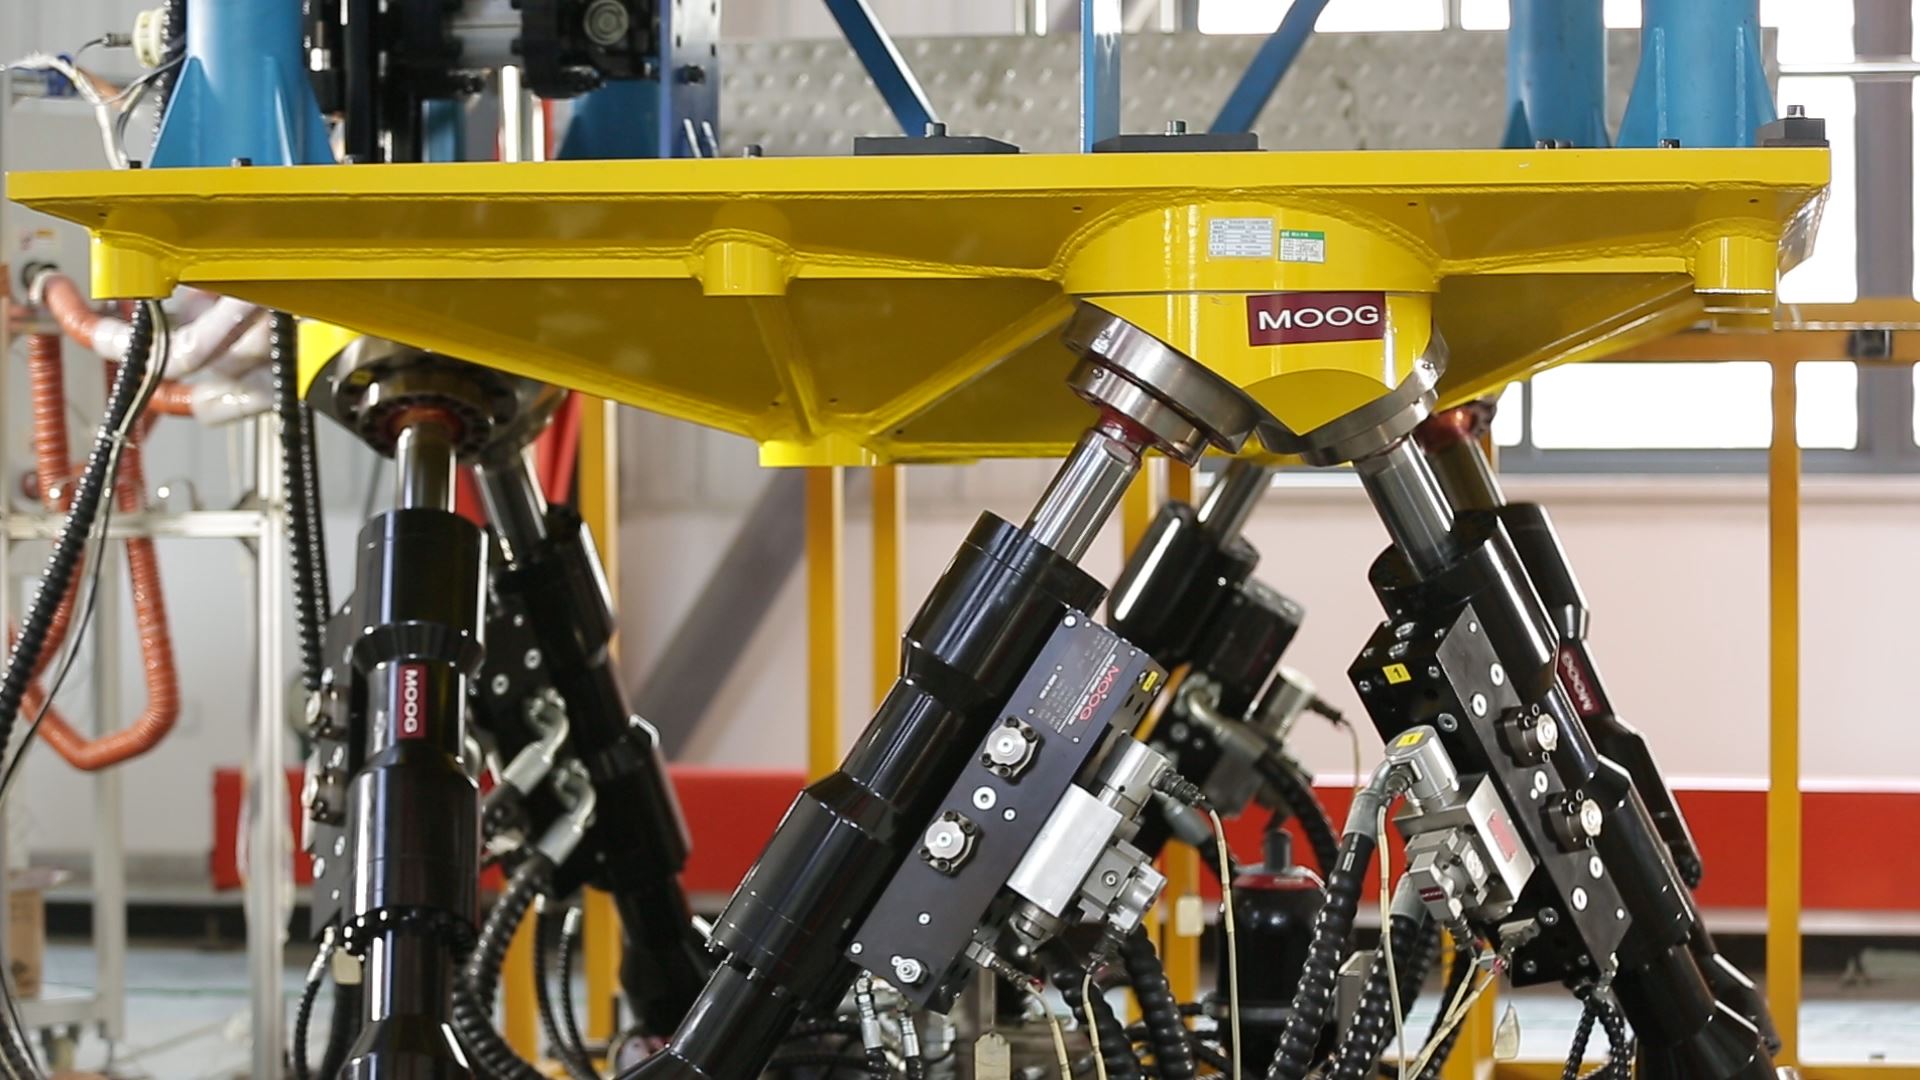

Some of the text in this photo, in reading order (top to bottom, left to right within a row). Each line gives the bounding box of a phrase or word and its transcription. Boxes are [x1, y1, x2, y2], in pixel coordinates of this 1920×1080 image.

[1258, 304, 1379, 331] MOOG
[1079, 665, 1120, 720] MOOG
[1393, 667, 1403, 679] 1
[1561, 652, 1594, 711] MOOG
[404, 669, 418, 733] MOOG
